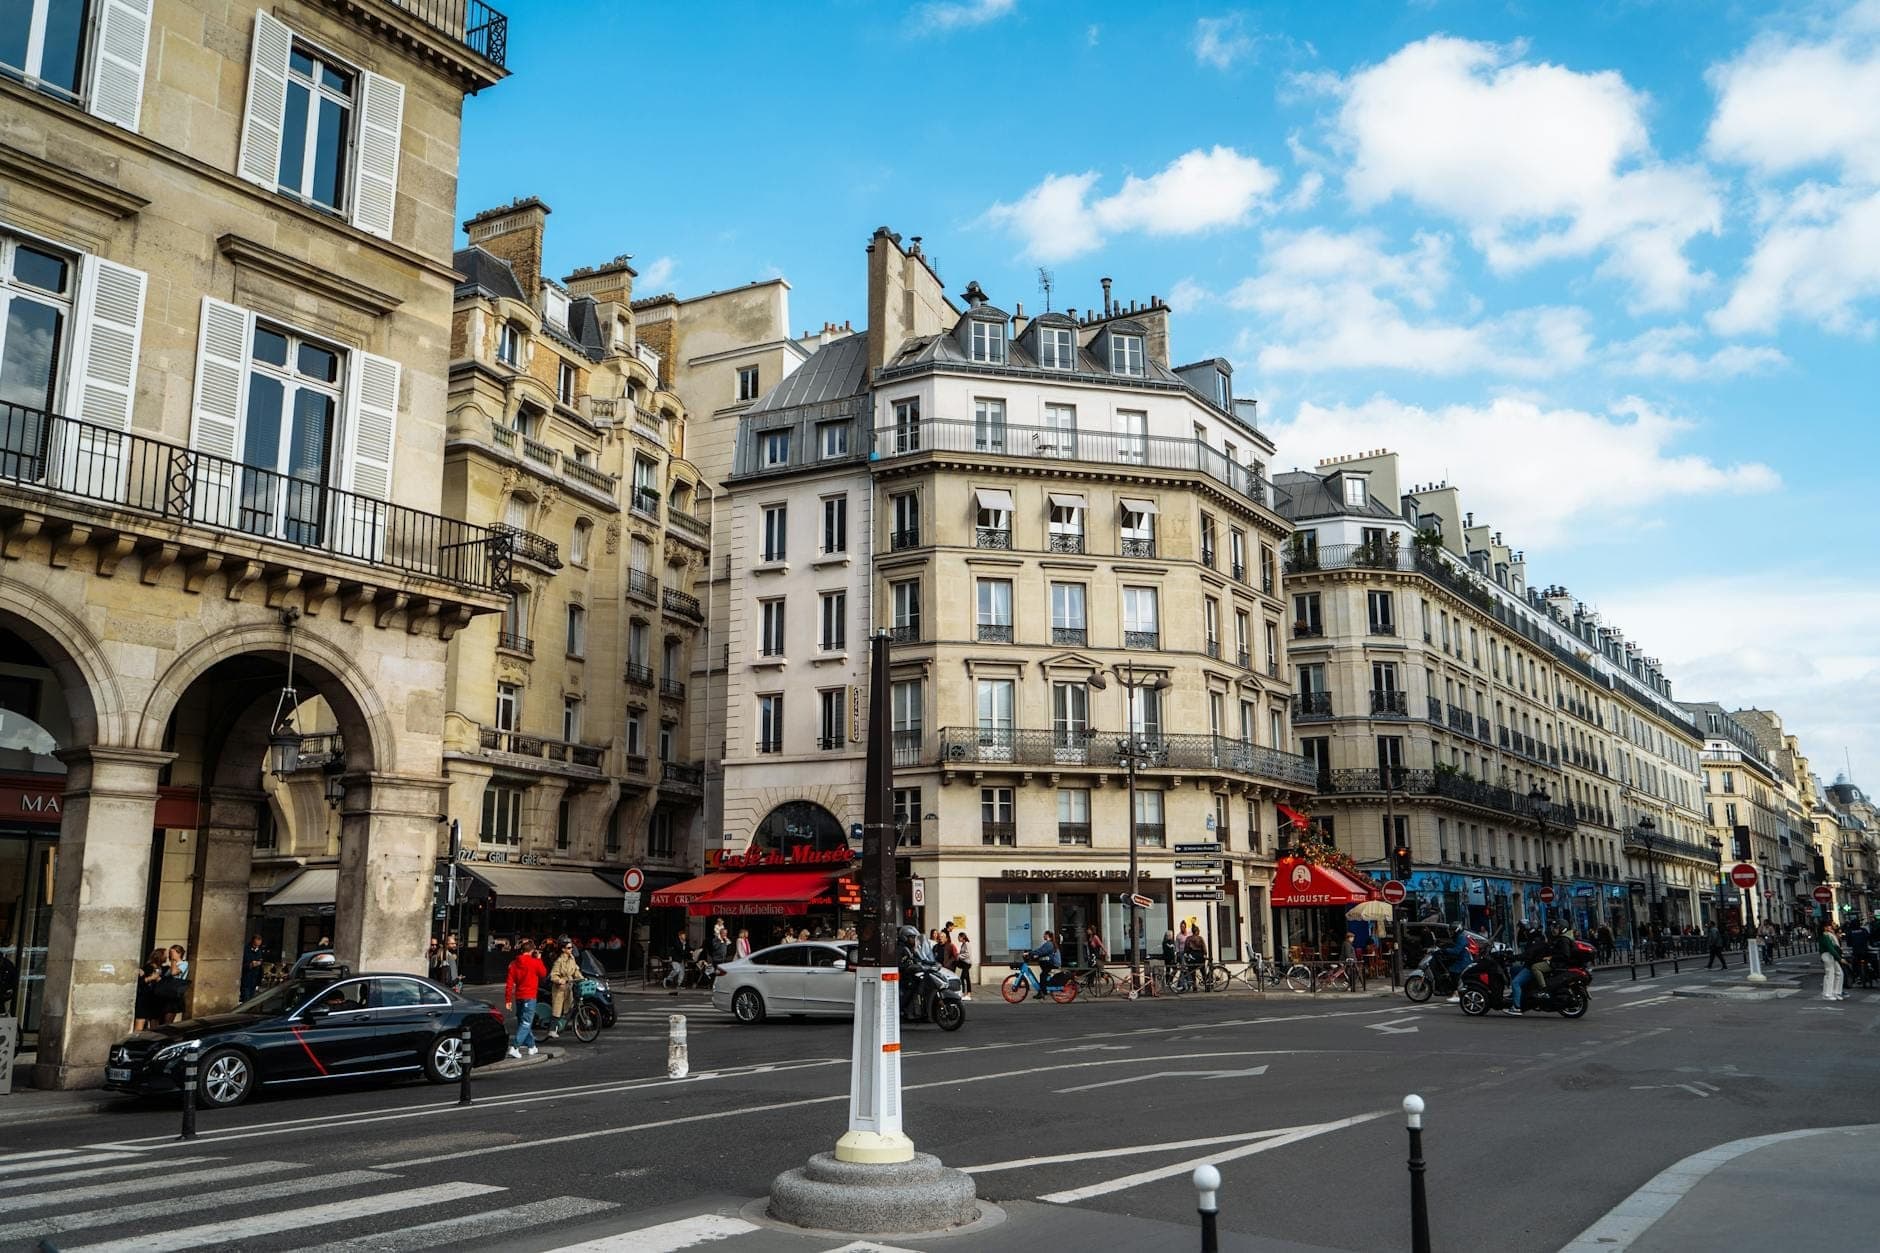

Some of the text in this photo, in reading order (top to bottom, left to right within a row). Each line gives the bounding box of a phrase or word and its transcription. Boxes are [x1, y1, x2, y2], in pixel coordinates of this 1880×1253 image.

[713, 843, 856, 867] Café du Musée
[1001, 869, 1152, 879] BRED PROFESSIONS LIBERES
[1287, 894, 1330, 903] AUGUSTE
[713, 903, 784, 915] Chez Micheline
